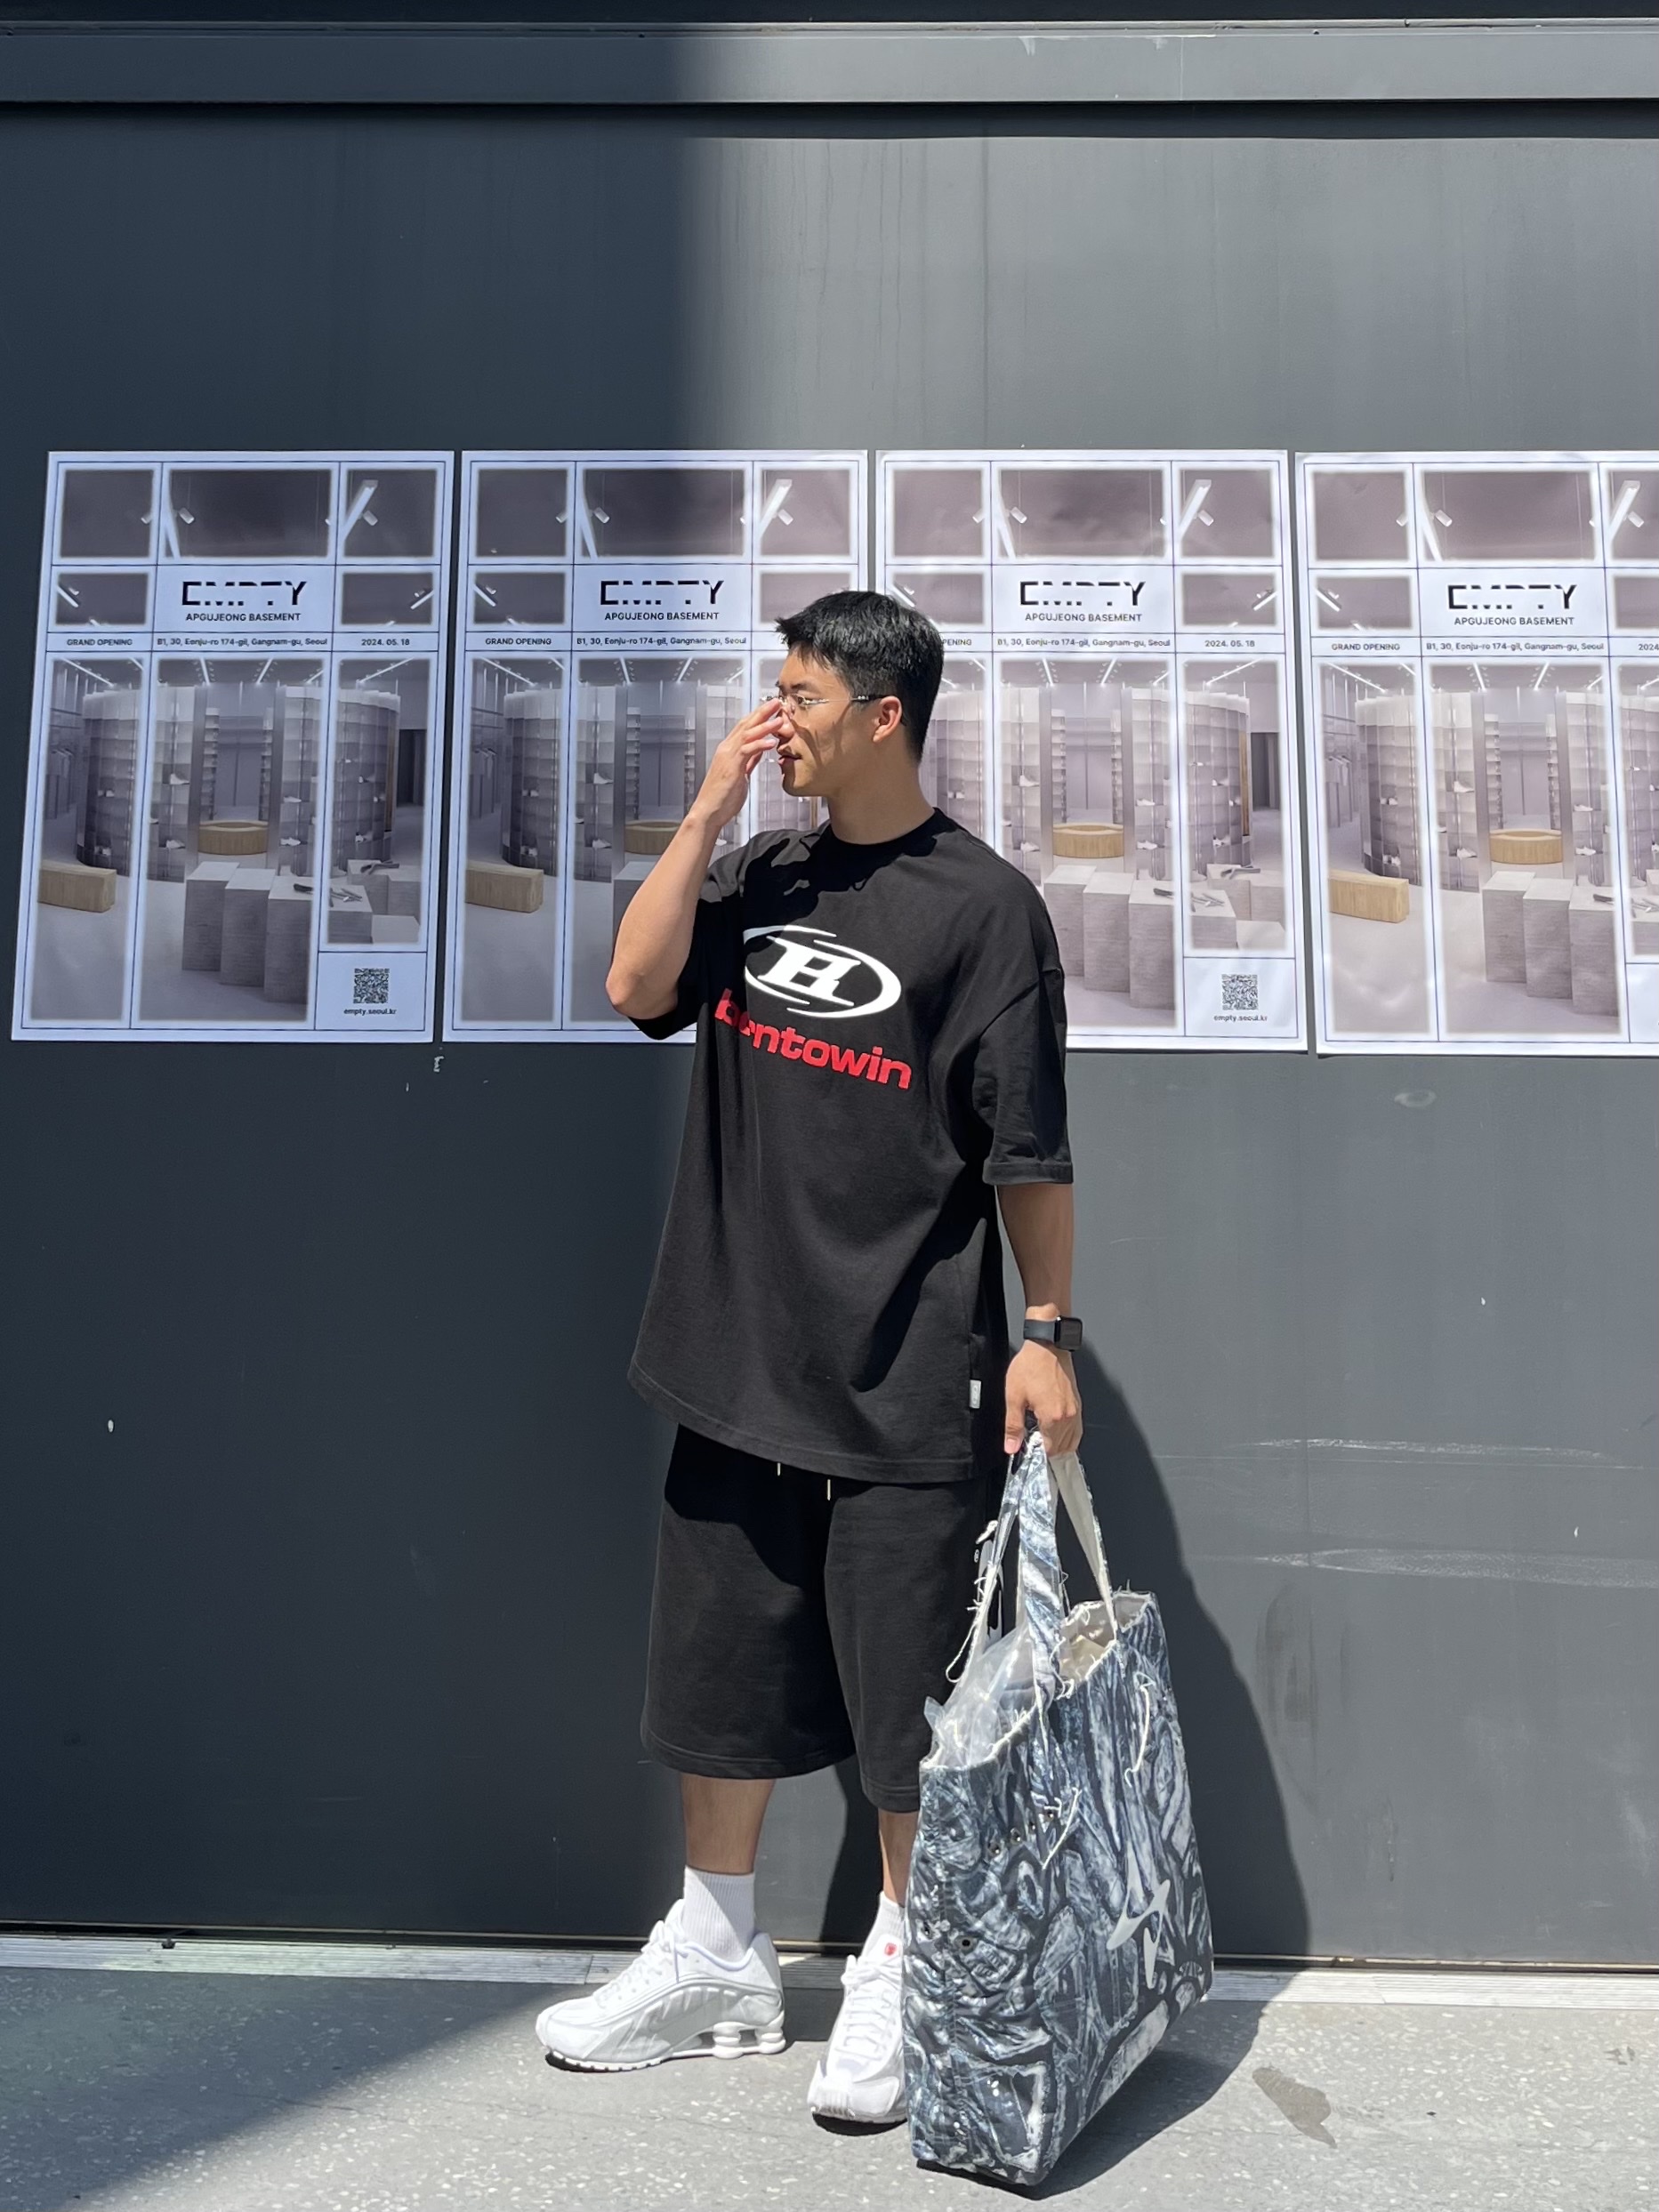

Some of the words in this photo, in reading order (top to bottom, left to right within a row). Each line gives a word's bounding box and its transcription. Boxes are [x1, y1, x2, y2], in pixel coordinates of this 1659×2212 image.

[185, 613, 246, 622] APGUJEONG
[249, 613, 302, 622] BASEMENT
[605, 612, 664, 621] APGUJEONG
[666, 612, 720, 621] BASEMENT
[1025, 613, 1085, 622] APGUJEONG
[1088, 614, 1142, 622] BASEMENT
[1454, 617, 1517, 625] APGUJEONG
[1519, 617, 1574, 625] BASEMENT
[67, 638, 95, 646] GRAND
[97, 638, 133, 646] OPENING
[305, 638, 327, 646] Seoul
[725, 637, 746, 645] Seoul
[1148, 639, 1170, 647] Seoul
[1204, 639, 1228, 648] 2024.
[1230, 639, 1244, 648] 05.
[1245, 639, 1255, 648] 18
[1332, 643, 1360, 651] GRAND
[1363, 643, 1400, 651] OPENING
[1582, 642, 1604, 650] Seoul
